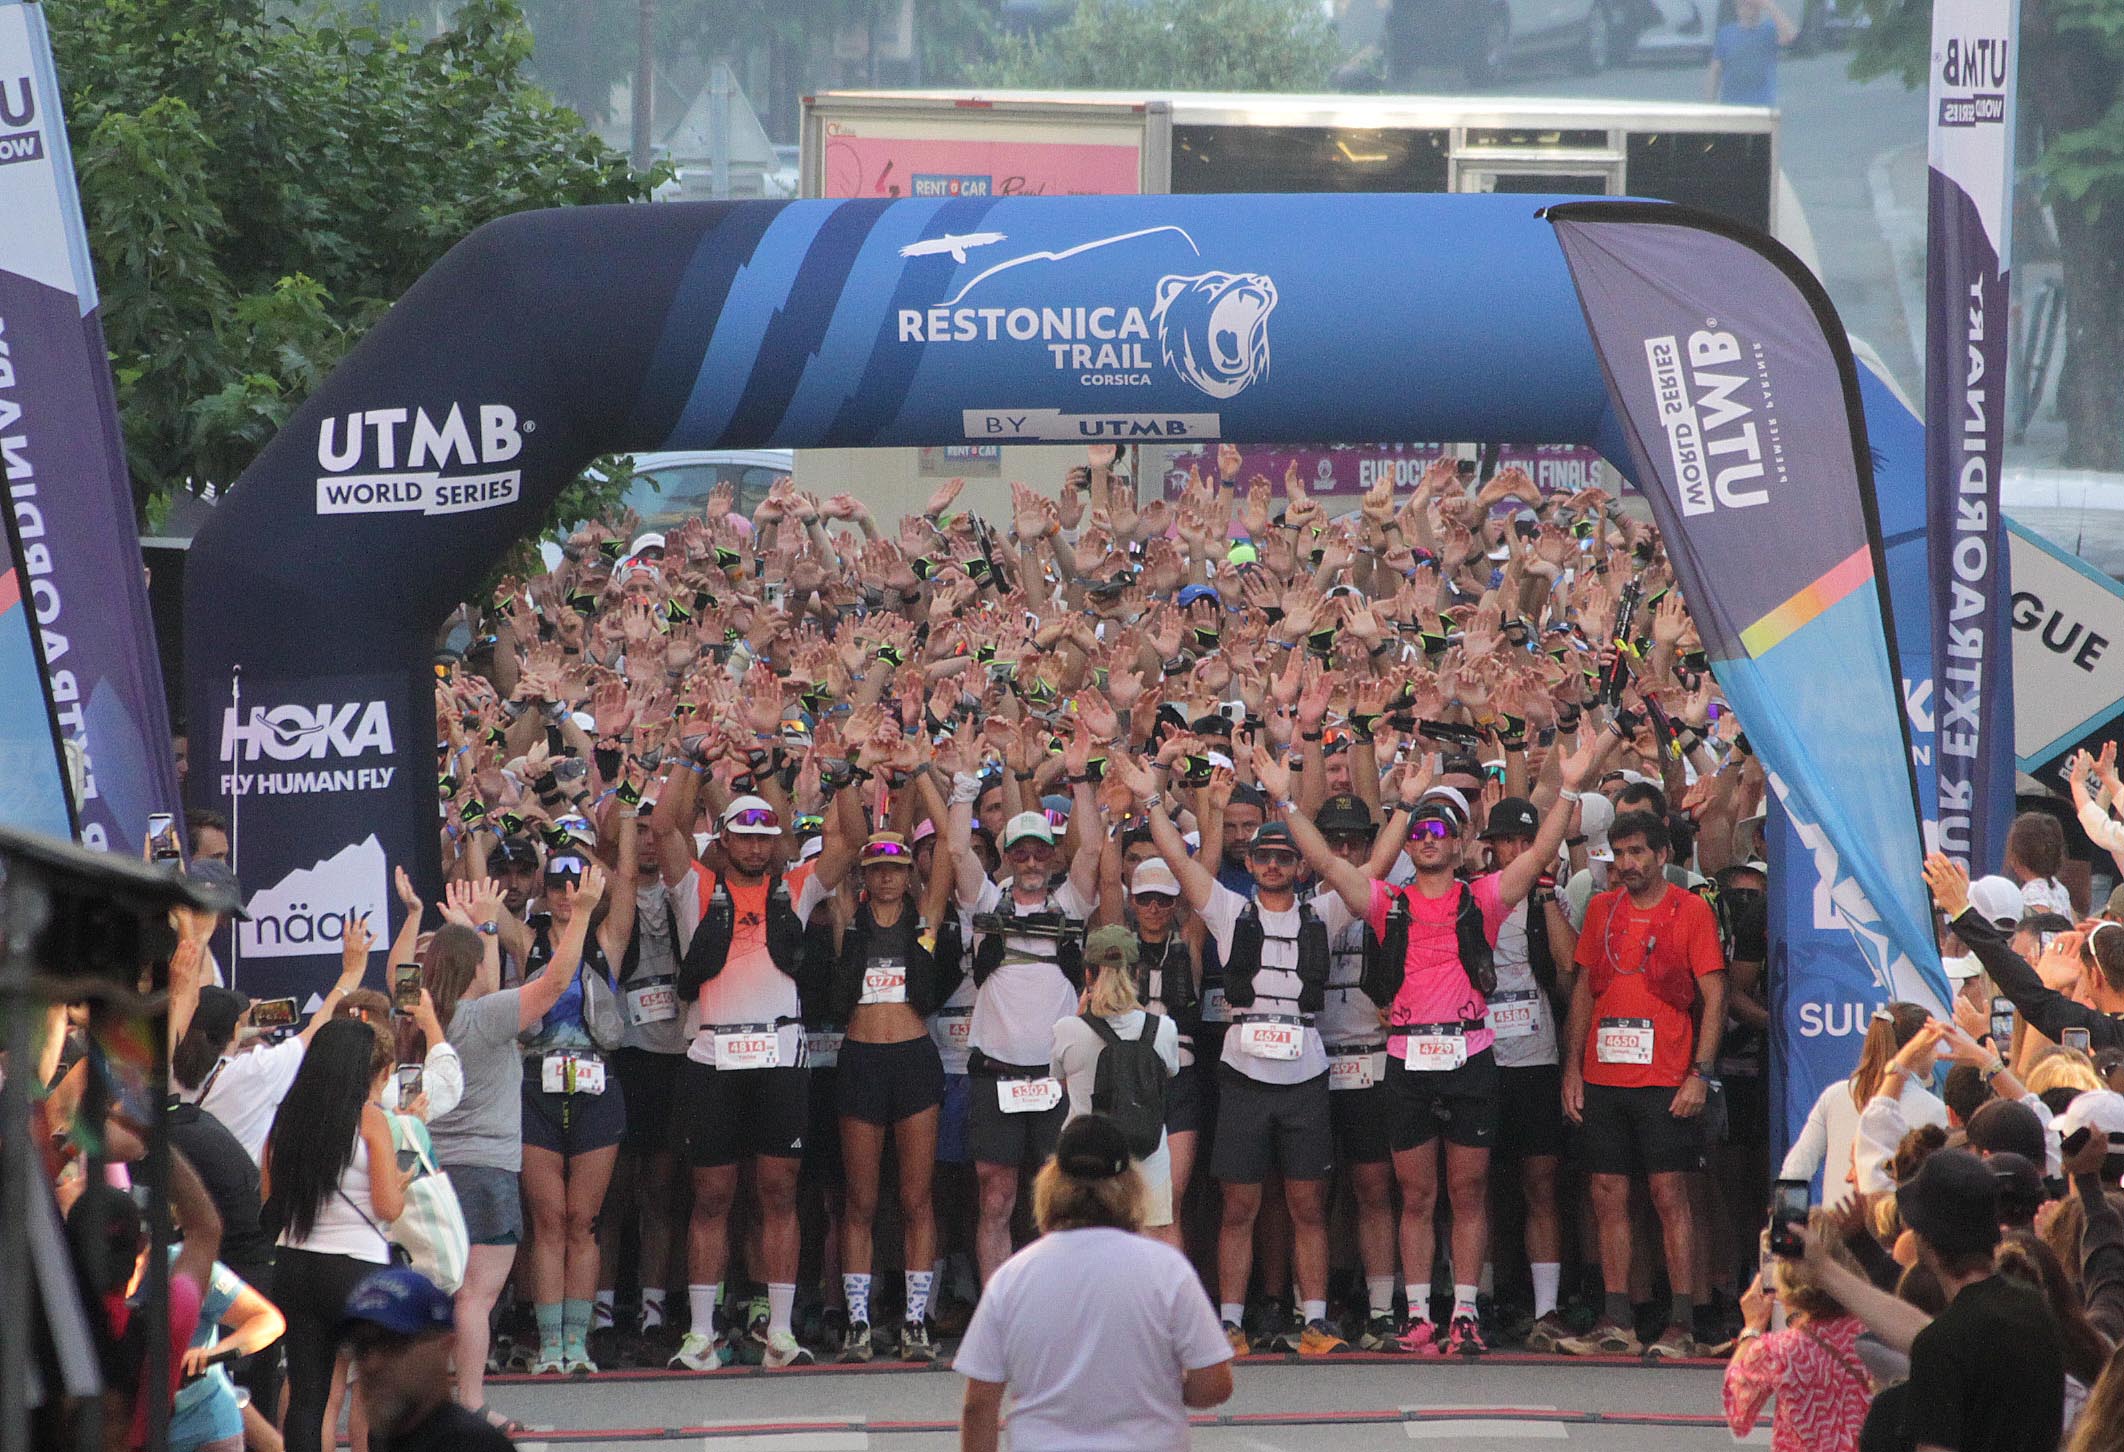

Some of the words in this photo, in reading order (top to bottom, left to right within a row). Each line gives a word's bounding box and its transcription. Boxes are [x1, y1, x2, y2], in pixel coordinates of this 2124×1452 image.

[916, 181, 947, 196] RENT
[961, 182, 987, 196] CAR
[898, 307, 1150, 342] RESTONICA
[1047, 344, 1152, 370] TRAIL
[1080, 374, 1152, 386] CORSICA
[986, 416, 1027, 433] BY
[1079, 420, 1187, 437] UTMB
[1539, 460, 1601, 489] FINALS
[326, 482, 423, 505] WORLD
[436, 478, 513, 506] SERIES
[220, 701, 394, 761] HOKA
[221, 773, 254, 796] FLY
[258, 769, 354, 795] HUMAN
[358, 766, 394, 790] FLY
[1255, 1030, 1289, 1043] 4671
[1606, 1036, 1637, 1047] 4650
